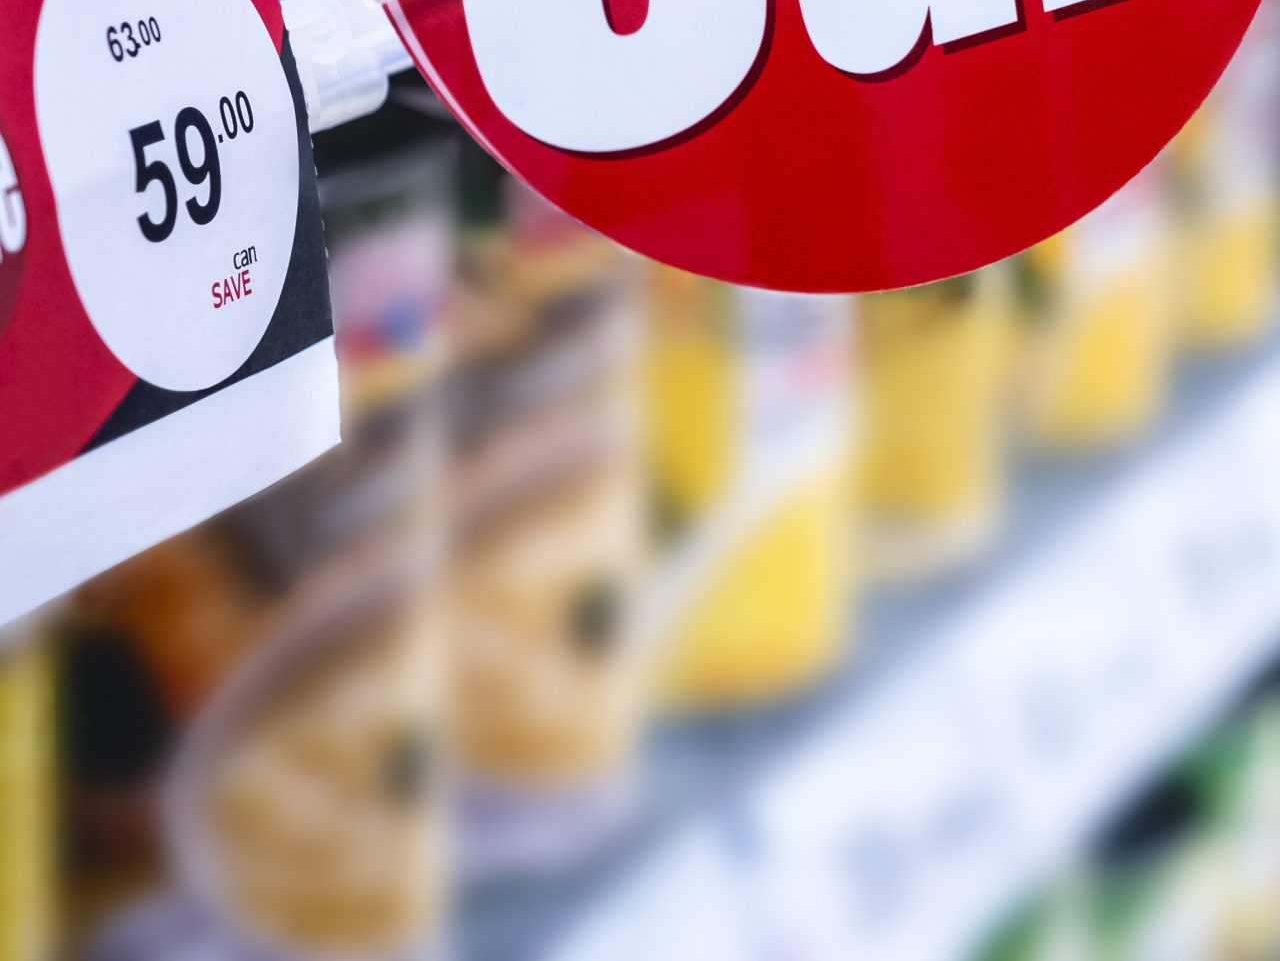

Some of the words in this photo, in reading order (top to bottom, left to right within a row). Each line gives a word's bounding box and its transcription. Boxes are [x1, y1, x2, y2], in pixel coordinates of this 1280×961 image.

[106, 16, 161, 62] 63.00
[129, 90, 254, 243] 59.00
[233, 245, 258, 270] can
[211, 269, 253, 309] SAVE
